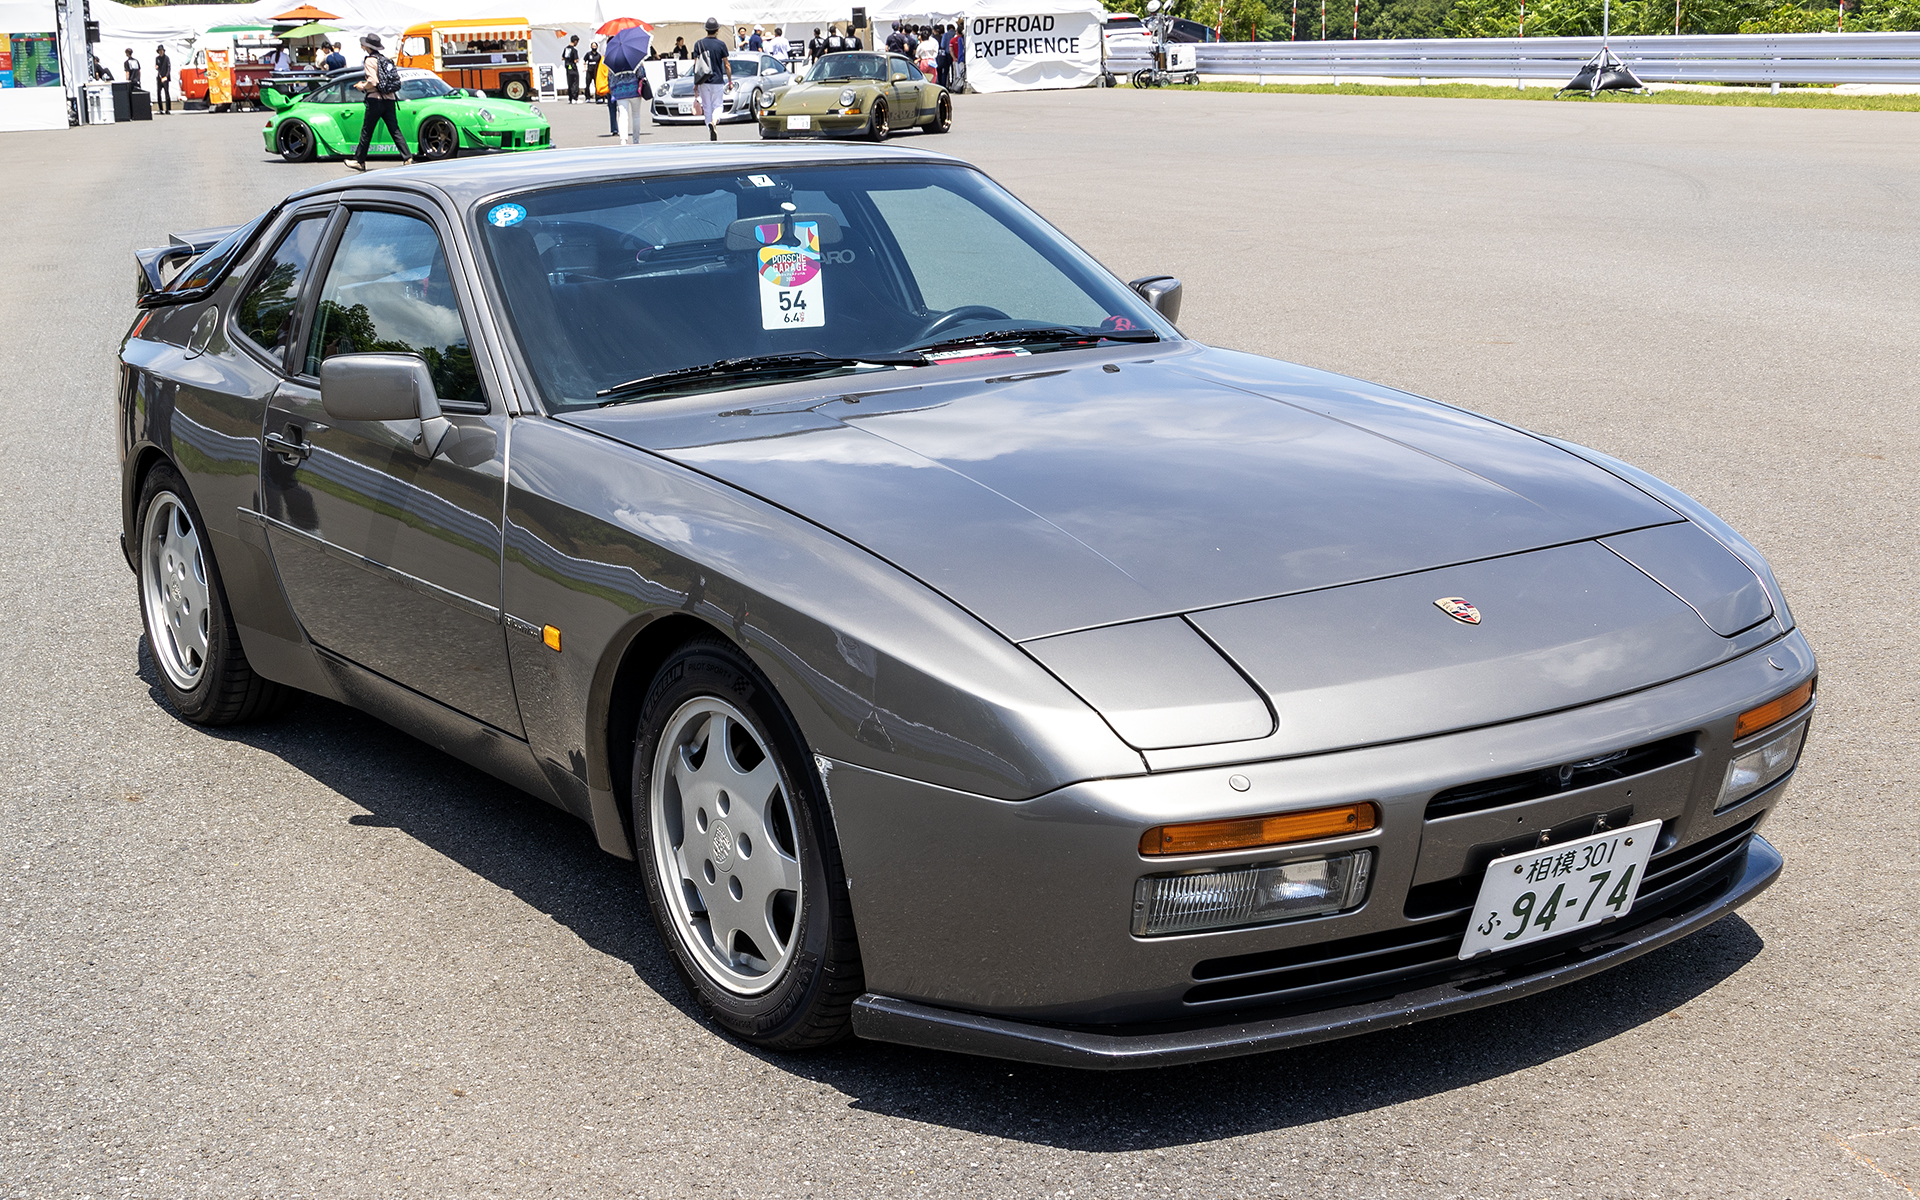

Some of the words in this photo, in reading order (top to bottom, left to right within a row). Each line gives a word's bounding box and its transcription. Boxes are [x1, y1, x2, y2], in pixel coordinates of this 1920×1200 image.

[973, 15, 1055, 36] OFFROAD
[974, 37, 1080, 59] EXPERIENCE
[772, 253, 807, 264] PORSCHE
[820, 250, 855, 264] ARO
[772, 262, 807, 273] GARAGE
[778, 290, 807, 311] 54
[783, 312, 799, 323] 6.4
[688, 662, 706, 671] PILOT
[706, 663, 728, 678] SPORT
[1477, 911, 1502, 936] ふ
[1503, 863, 1637, 941] 94-74
